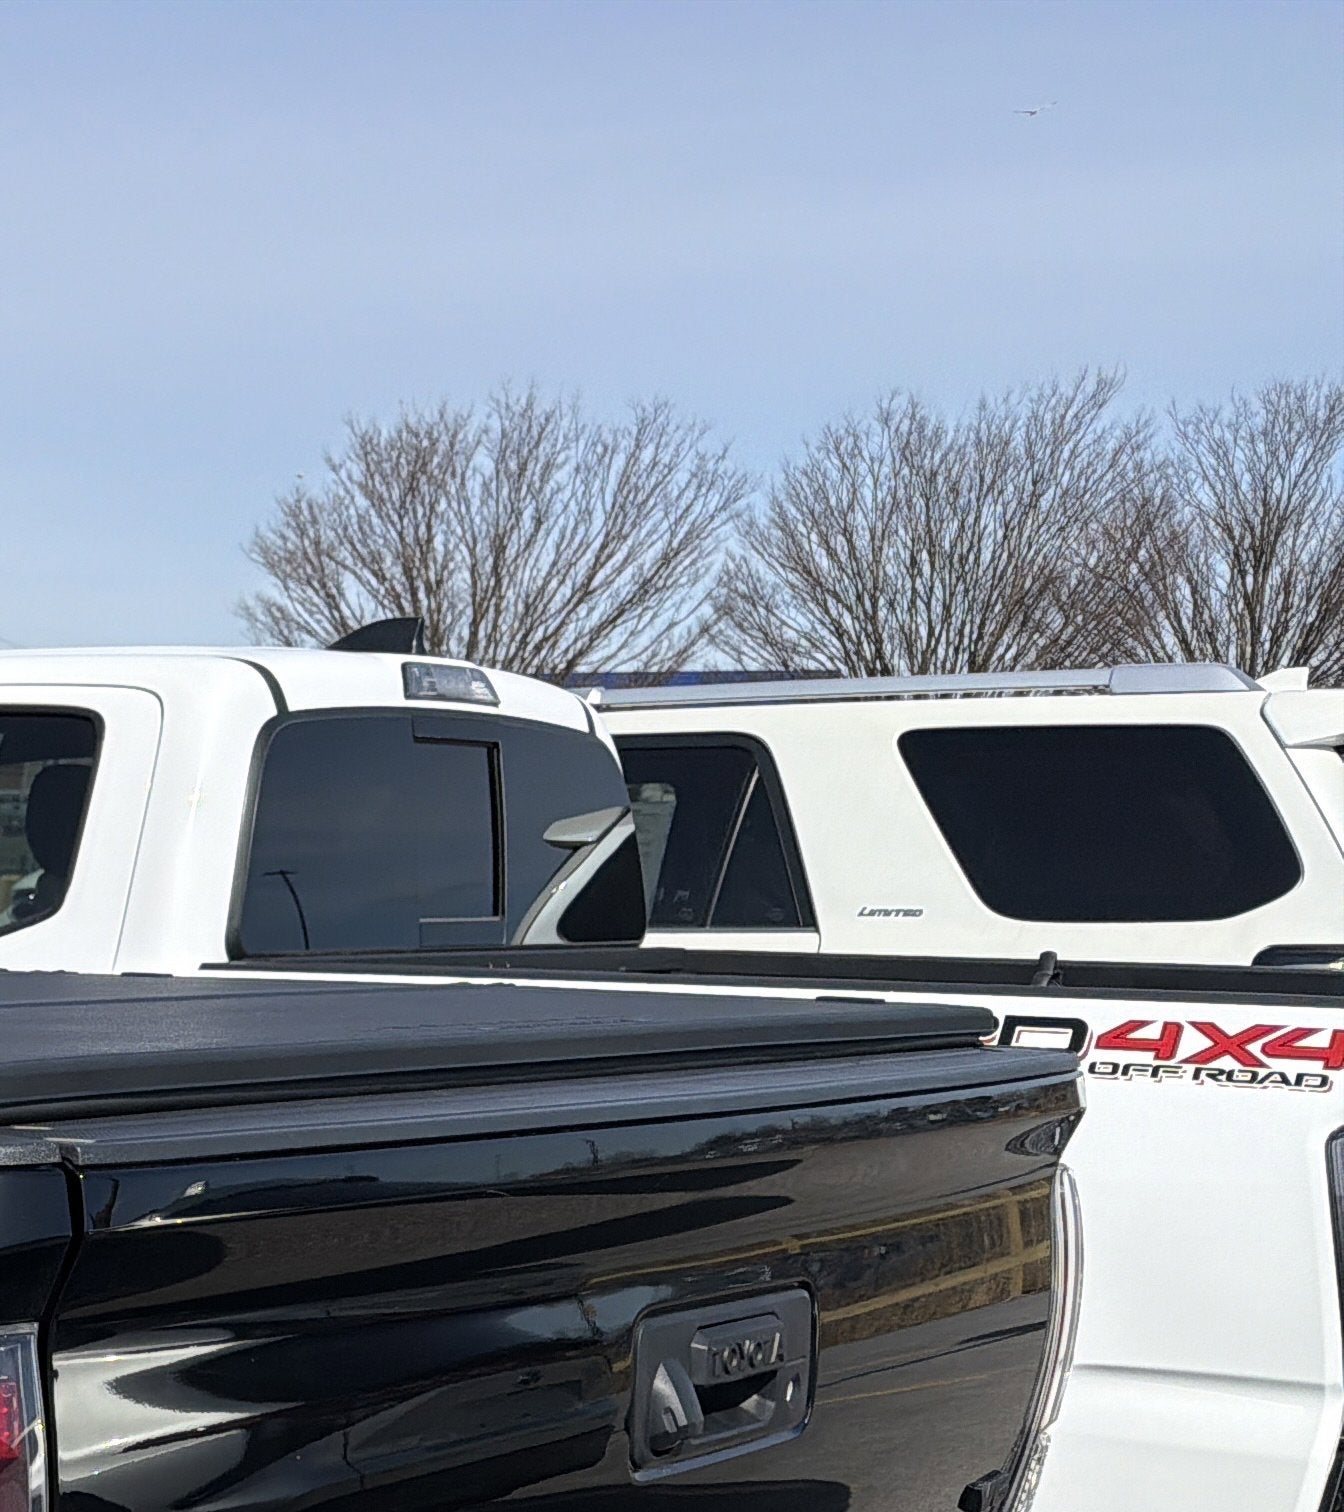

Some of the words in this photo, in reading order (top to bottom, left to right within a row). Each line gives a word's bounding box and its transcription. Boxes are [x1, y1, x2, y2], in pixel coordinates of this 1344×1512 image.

[1093, 1019, 1344, 1071] 4X4
[1087, 1061, 1185, 1083] OFF
[1192, 1066, 1334, 1092] ROAD
[711, 1331, 785, 1378] TOYOTA
